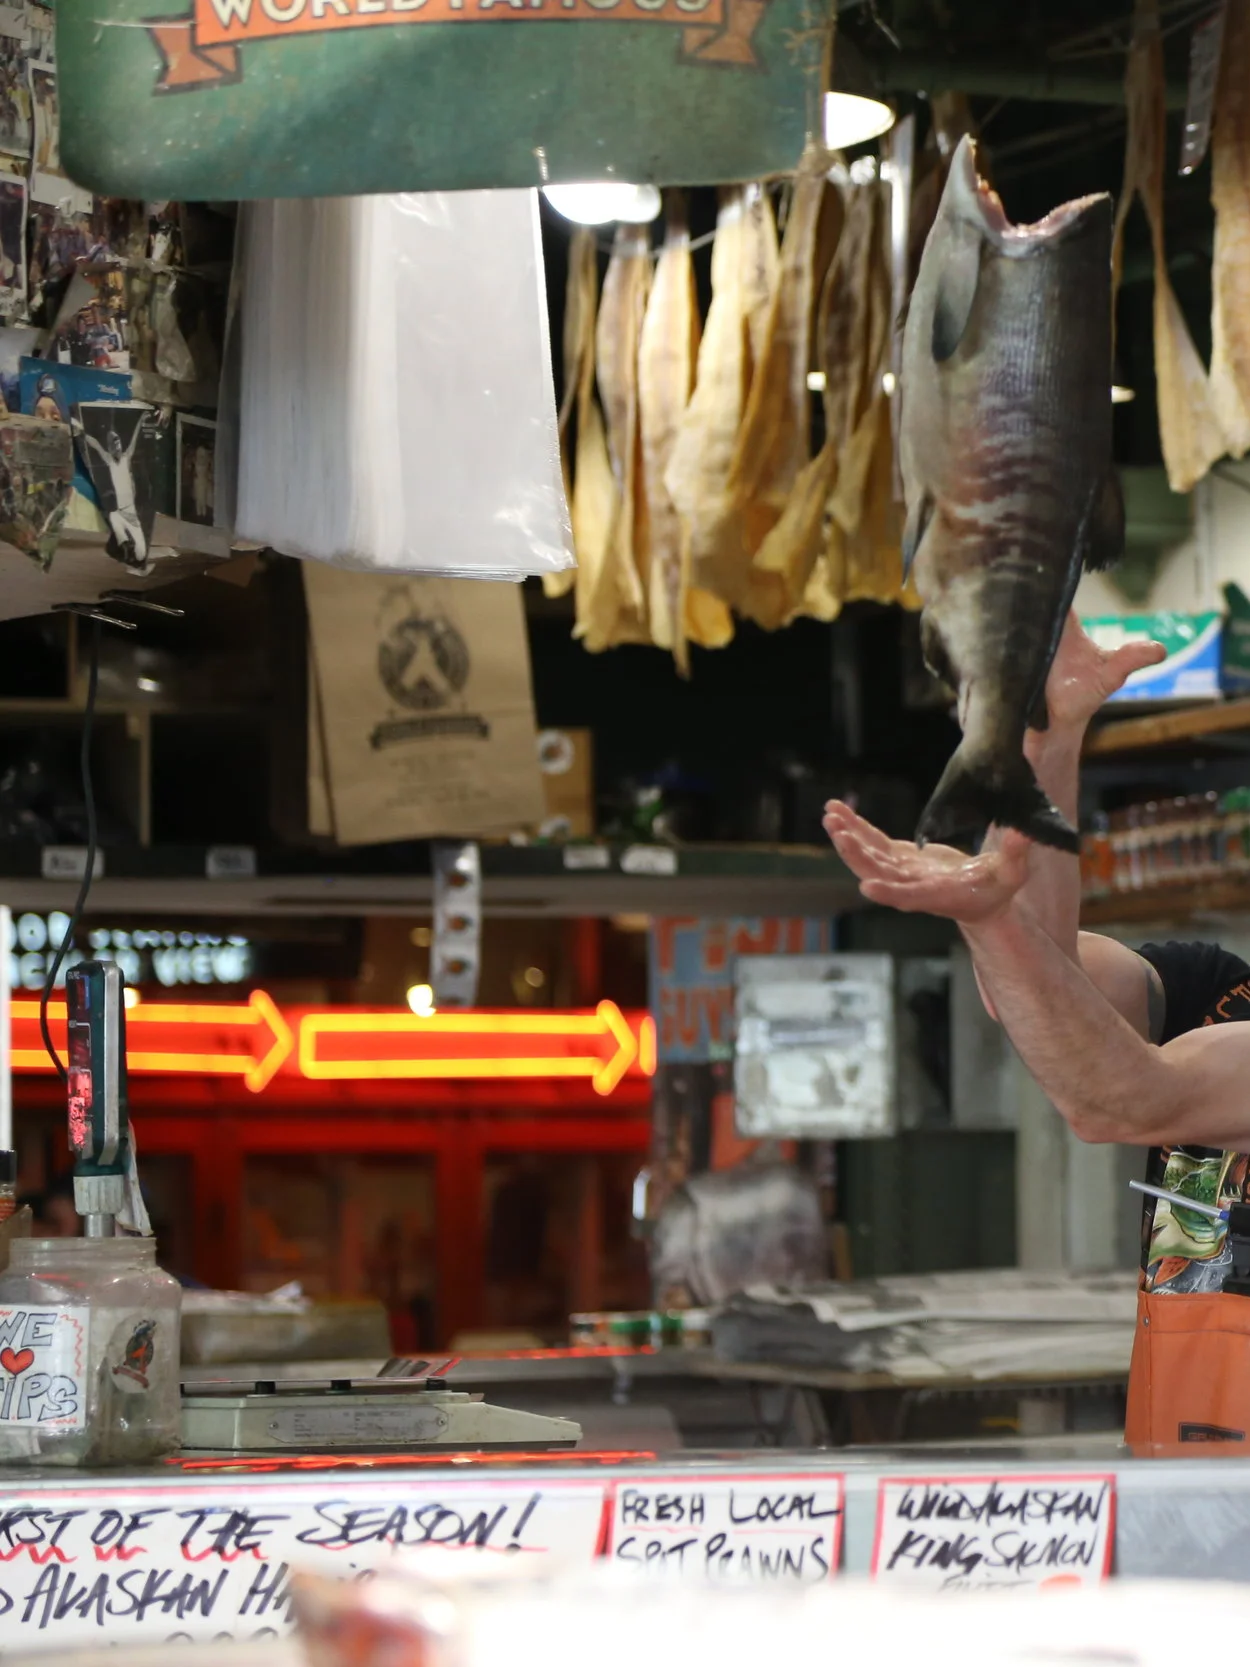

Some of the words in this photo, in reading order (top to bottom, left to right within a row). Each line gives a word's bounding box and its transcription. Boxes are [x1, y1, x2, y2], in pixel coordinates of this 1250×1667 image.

[0, 1372, 79, 1422] IPS
[90, 1507, 172, 1550] OF
[176, 1506, 292, 1555] THE
[622, 1488, 706, 1525] FRESH
[729, 1488, 843, 1526] LOCAL
[885, 1530, 983, 1575] KING
